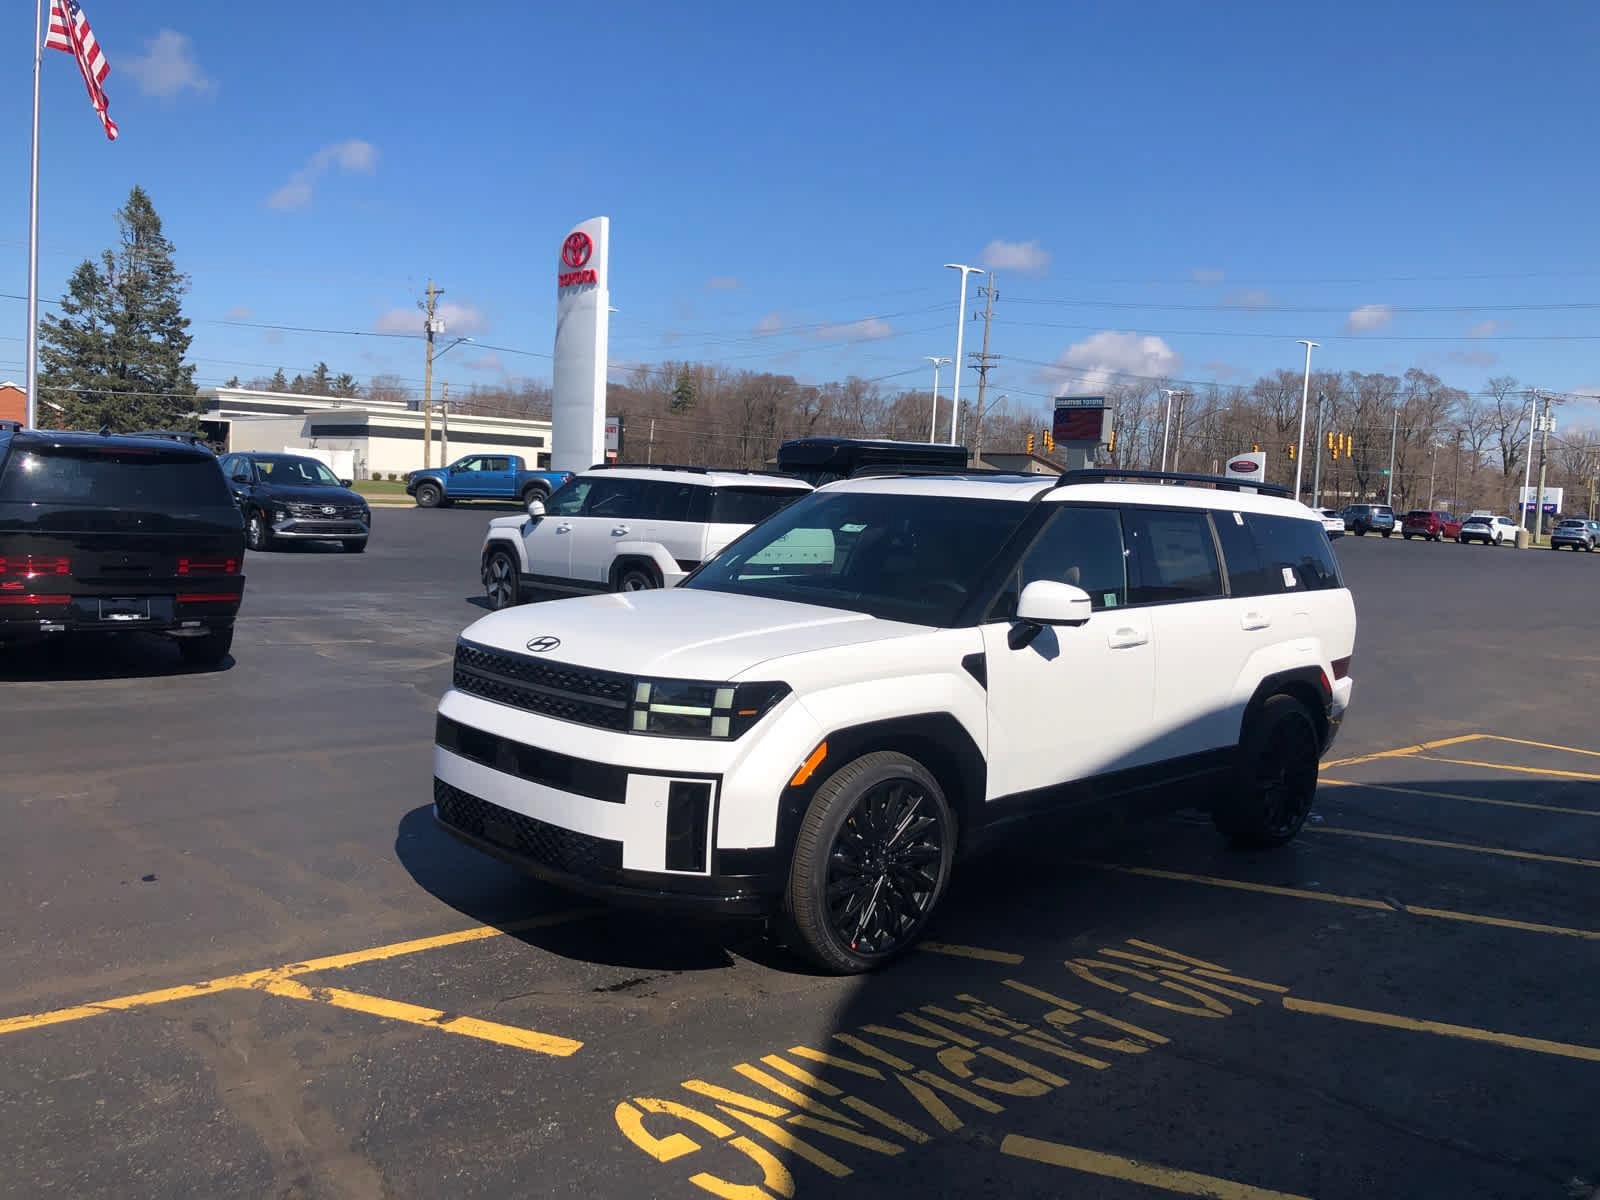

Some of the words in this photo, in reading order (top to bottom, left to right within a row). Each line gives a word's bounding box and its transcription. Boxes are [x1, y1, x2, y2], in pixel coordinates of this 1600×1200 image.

[559, 269, 597, 287] TOYOTA
[1065, 938, 1289, 1018] NO
[614, 979, 1170, 1200] PARKING
